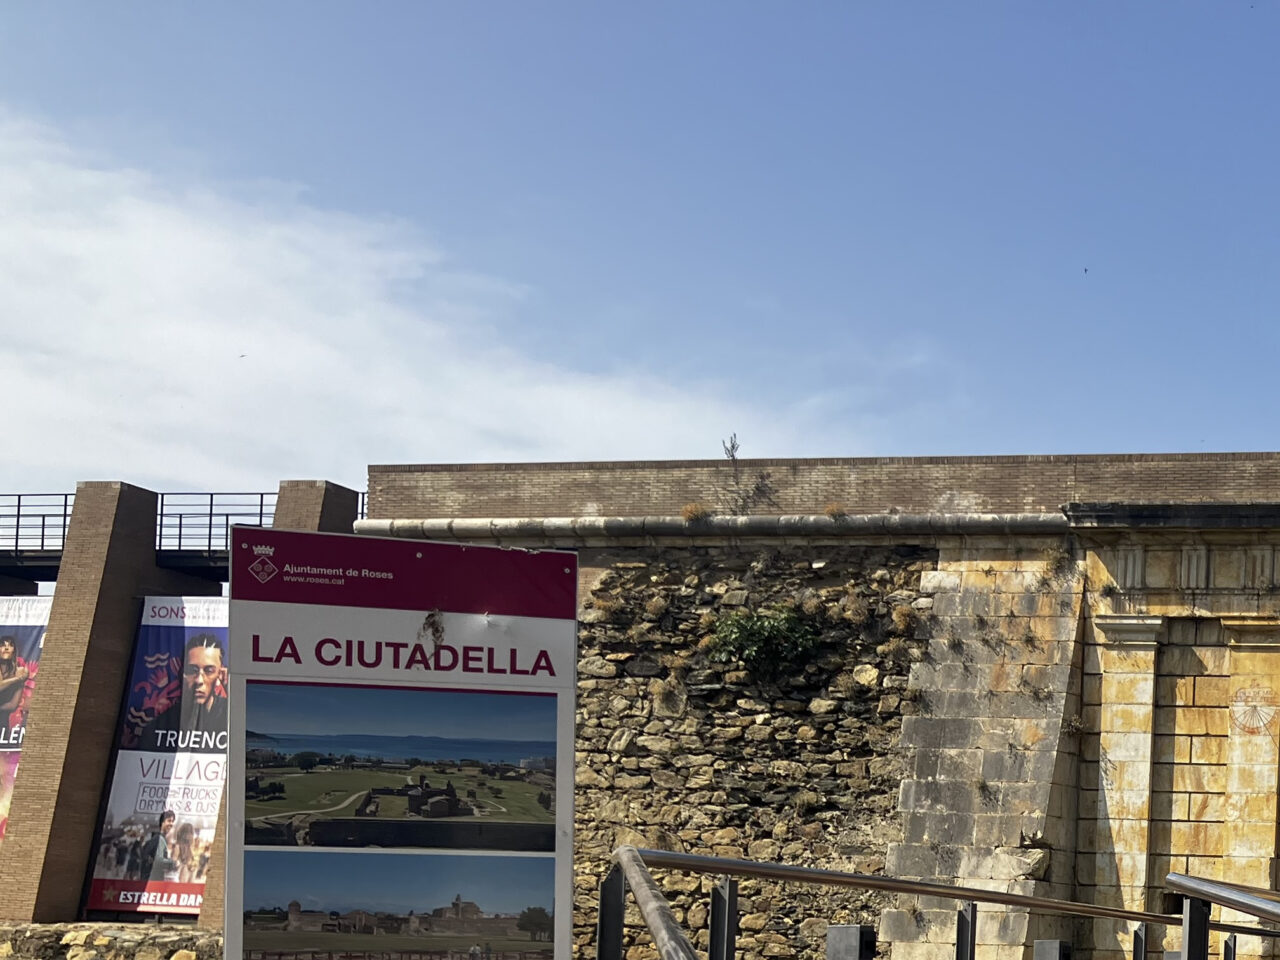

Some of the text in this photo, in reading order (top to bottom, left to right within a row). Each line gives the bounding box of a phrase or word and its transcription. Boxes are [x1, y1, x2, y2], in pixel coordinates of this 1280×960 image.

[282, 563, 394, 579] Ajuntament de Roses
[282, 575, 345, 585] www.roses.cat
[150, 605, 187, 620] SONS
[251, 633, 557, 677] LA CIUTADELLA
[141, 785, 170, 799] FOOD
[119, 891, 177, 906] ESTRELLA
